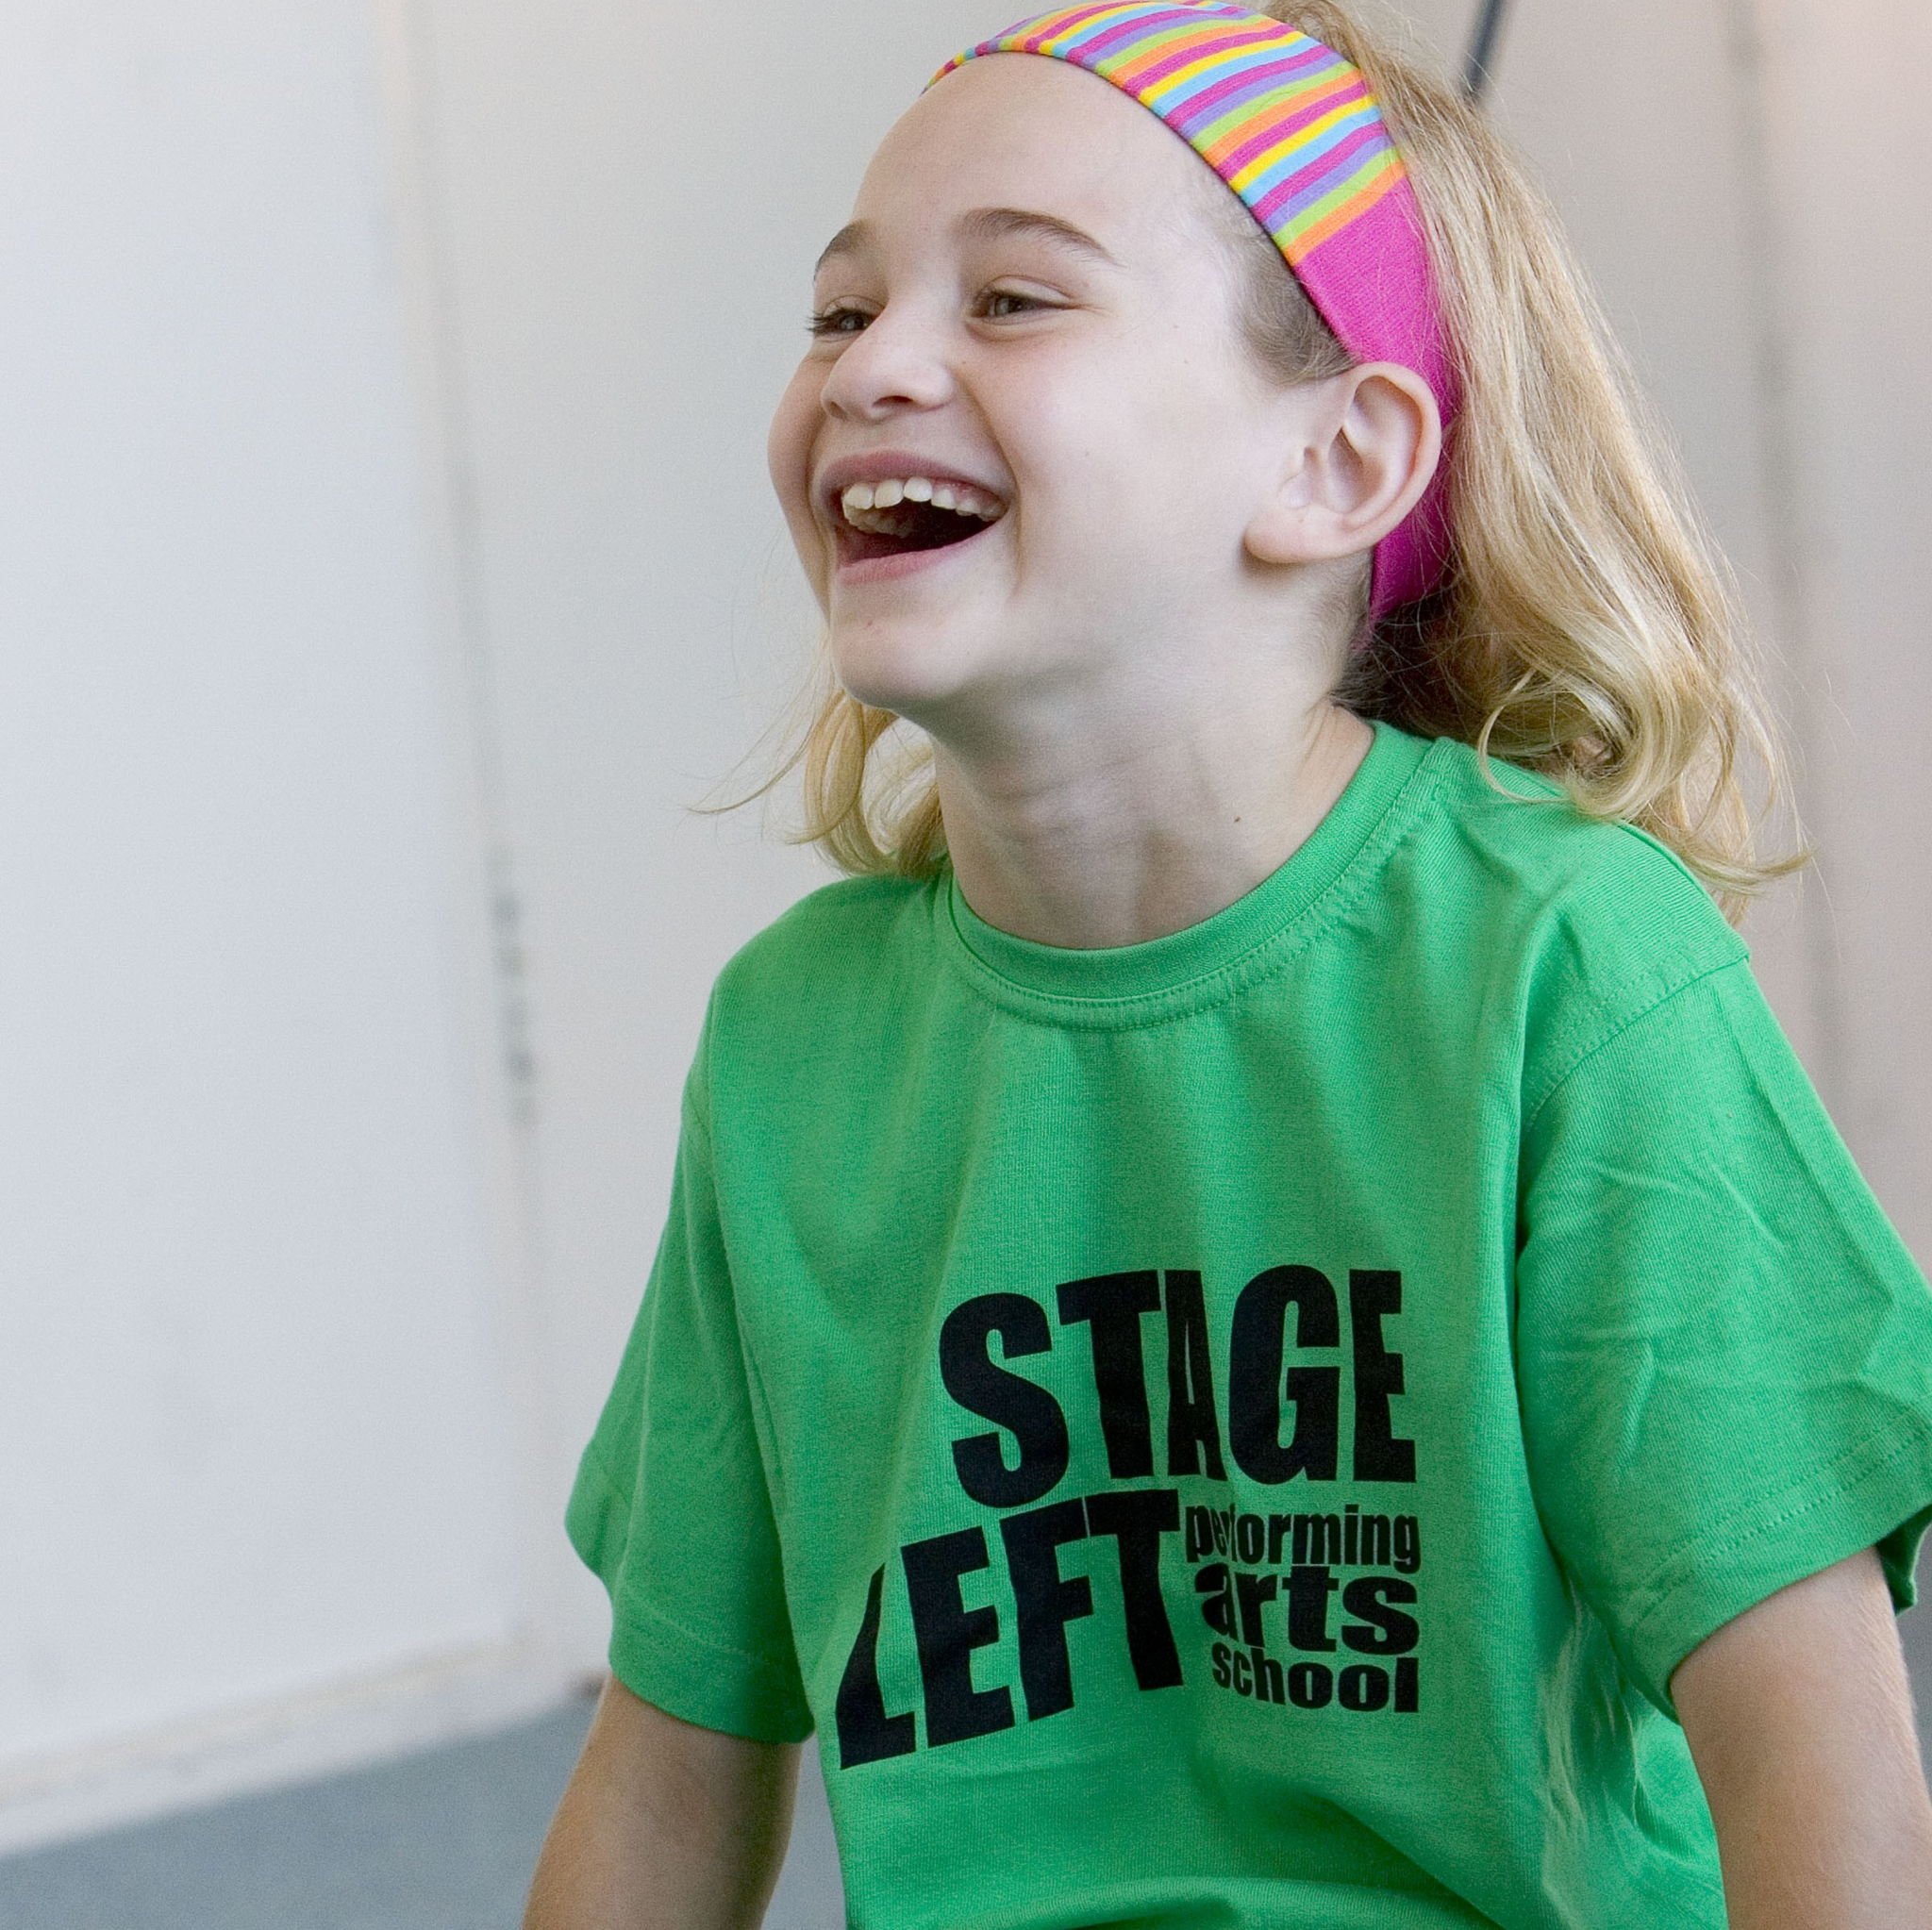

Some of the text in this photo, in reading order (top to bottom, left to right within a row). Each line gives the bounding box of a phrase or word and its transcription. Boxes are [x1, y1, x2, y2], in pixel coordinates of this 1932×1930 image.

[940, 1265, 1417, 1508] STAGE
[836, 1489, 1185, 1770] LEFT
[1193, 1562, 1421, 1655] arts
[1211, 1641, 1420, 1713] school
